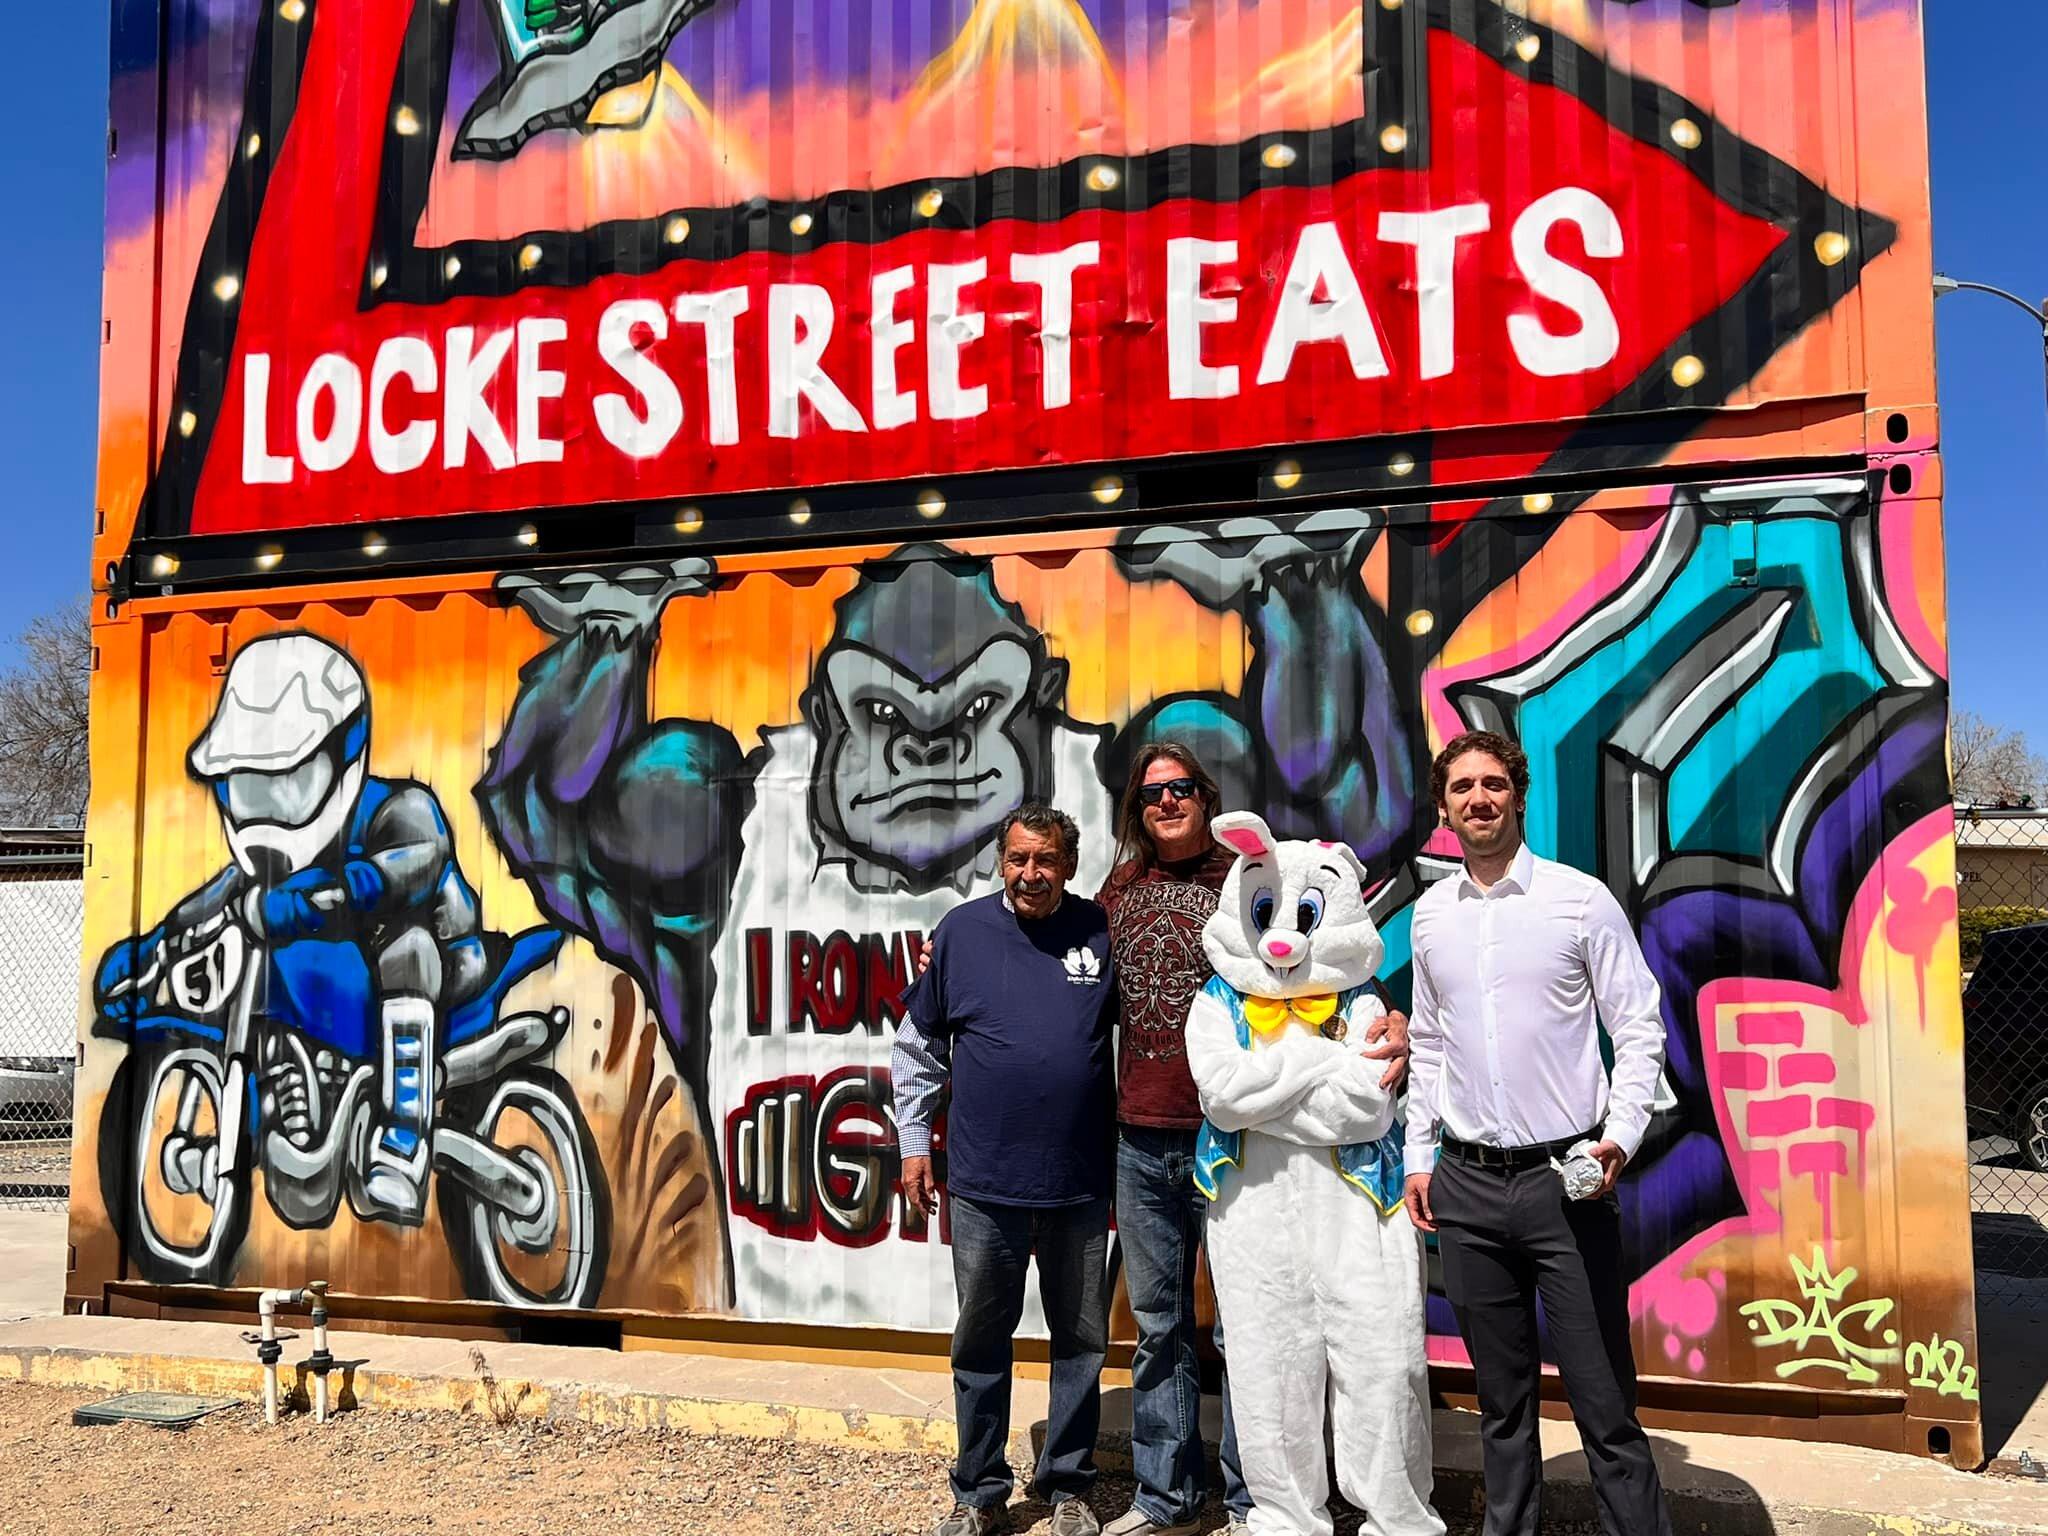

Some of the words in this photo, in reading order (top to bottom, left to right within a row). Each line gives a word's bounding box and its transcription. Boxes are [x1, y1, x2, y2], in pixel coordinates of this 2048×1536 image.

[242, 317, 568, 484] LOCKE
[593, 240, 1100, 458] STREET
[1167, 187, 1624, 399] EATS
